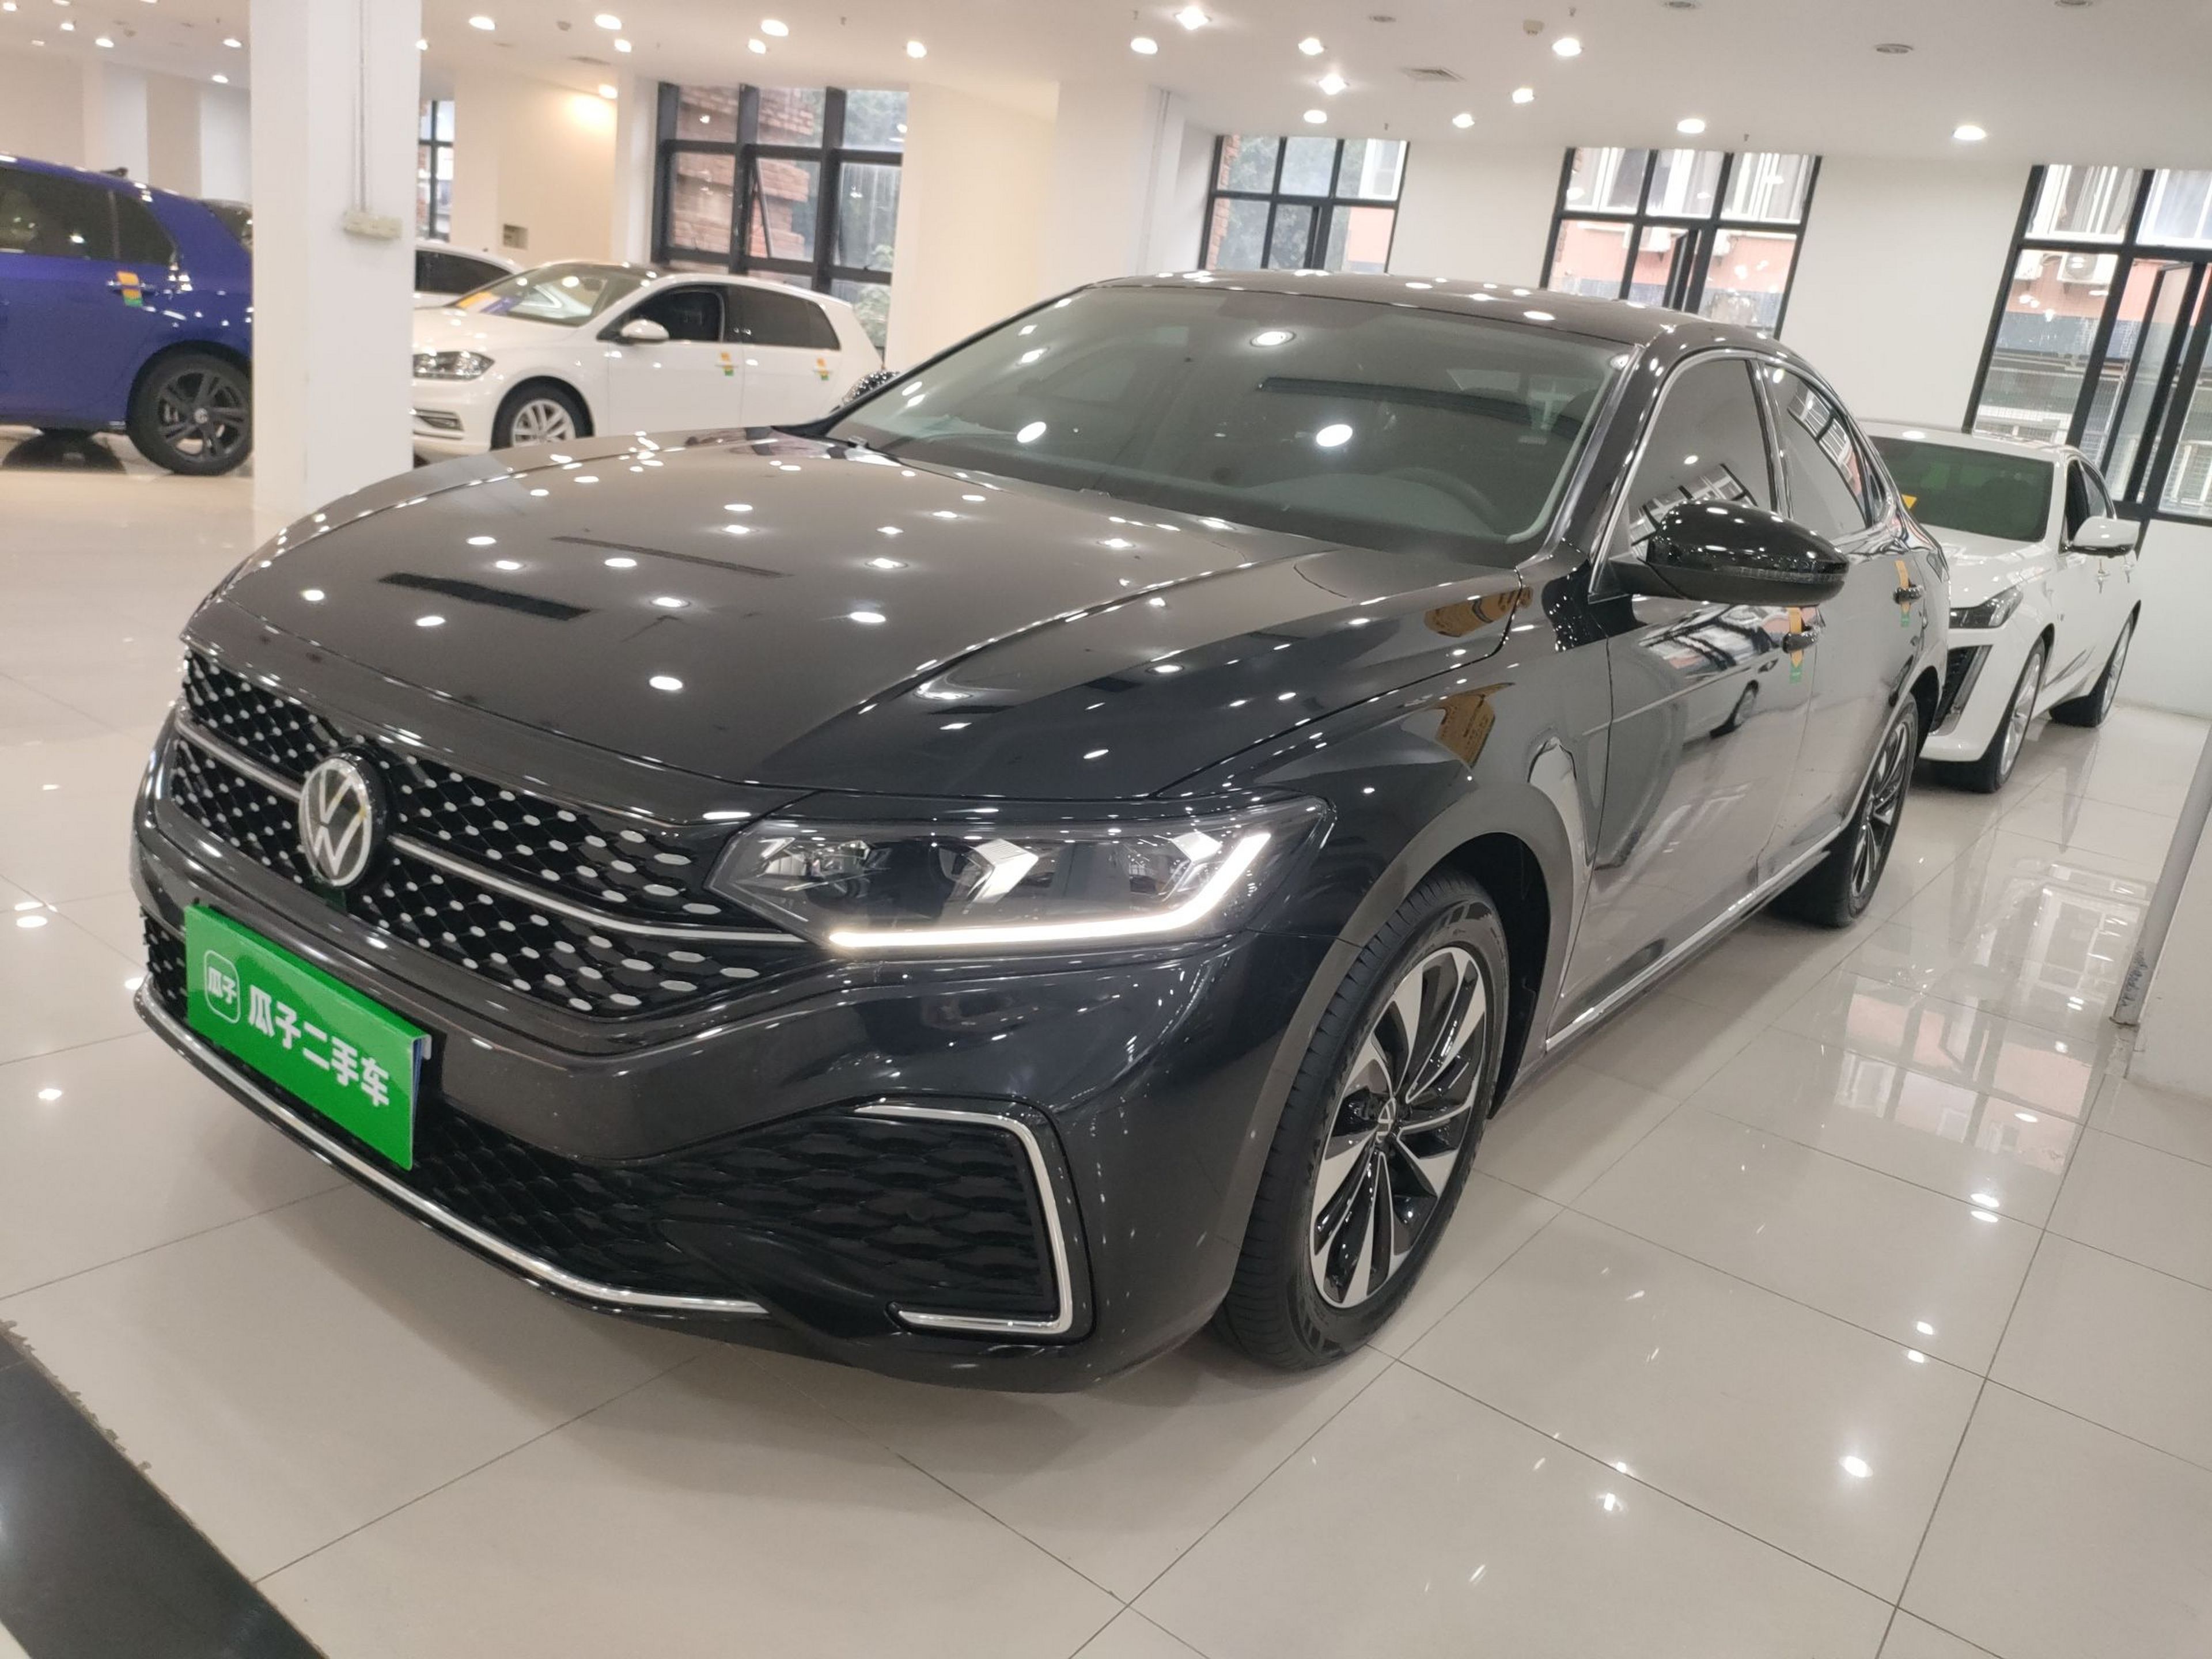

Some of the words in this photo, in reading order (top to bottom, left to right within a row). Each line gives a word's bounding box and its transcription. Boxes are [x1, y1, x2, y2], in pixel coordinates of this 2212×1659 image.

[299, 757, 373, 887] VW
[208, 966, 237, 1004] 瓜子
[248, 984, 389, 1107] 瓜子二手车
